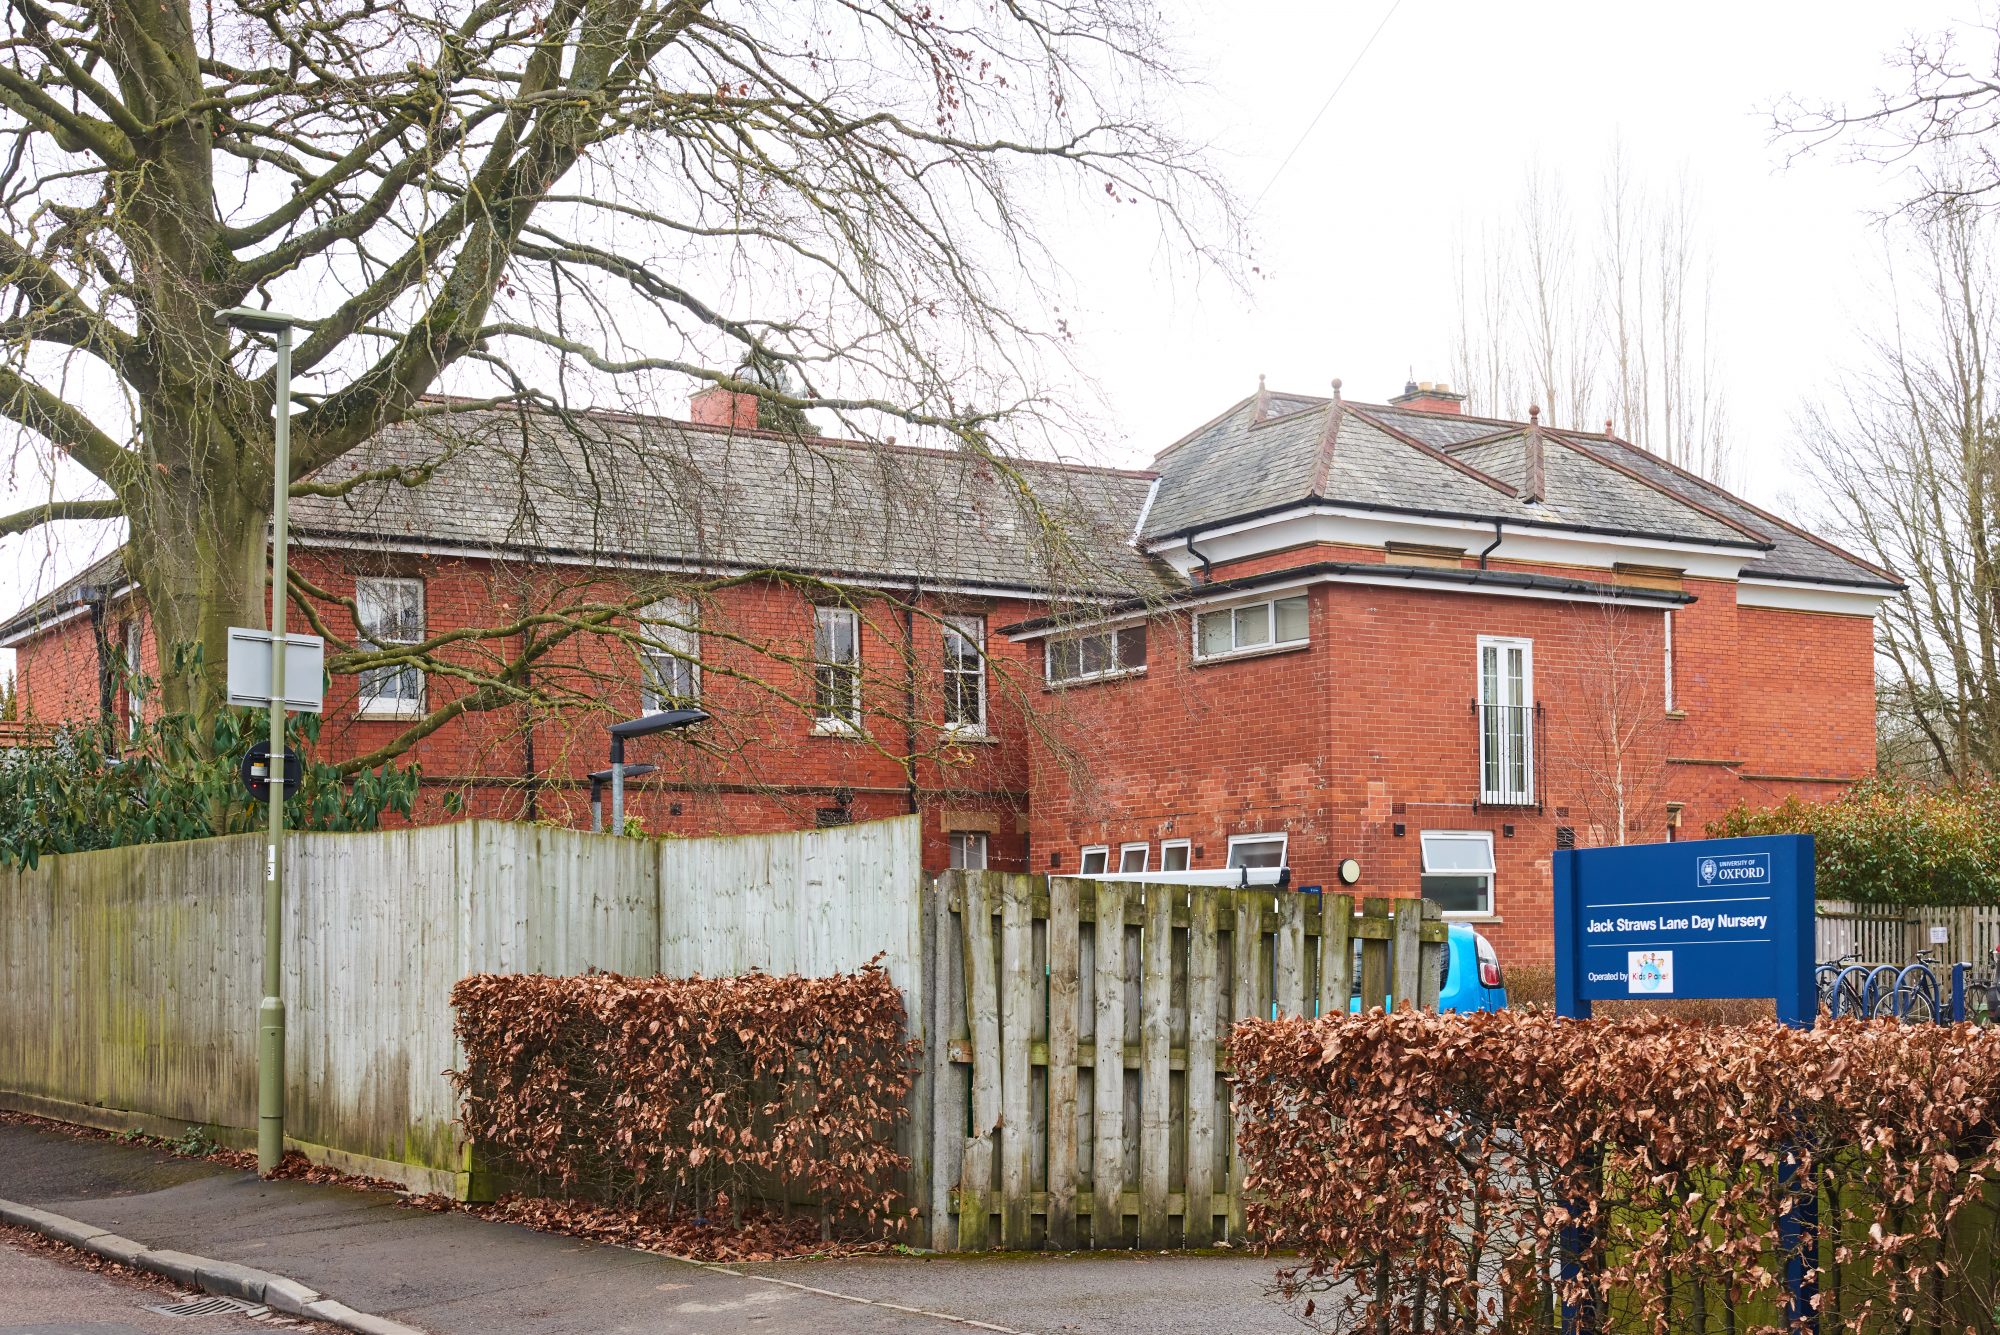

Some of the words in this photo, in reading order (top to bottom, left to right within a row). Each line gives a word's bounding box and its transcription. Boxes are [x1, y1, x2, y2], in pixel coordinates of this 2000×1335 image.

[1719, 867, 1764, 879] OXFORD
[1587, 919, 1614, 933] Jack
[1616, 917, 1657, 932] Straws
[1660, 916, 1688, 930] Lane
[1692, 915, 1714, 931] Day
[1718, 914, 1767, 929] Nursery
[1588, 972, 1618, 982] Operated
[1619, 972, 1628, 982] by
